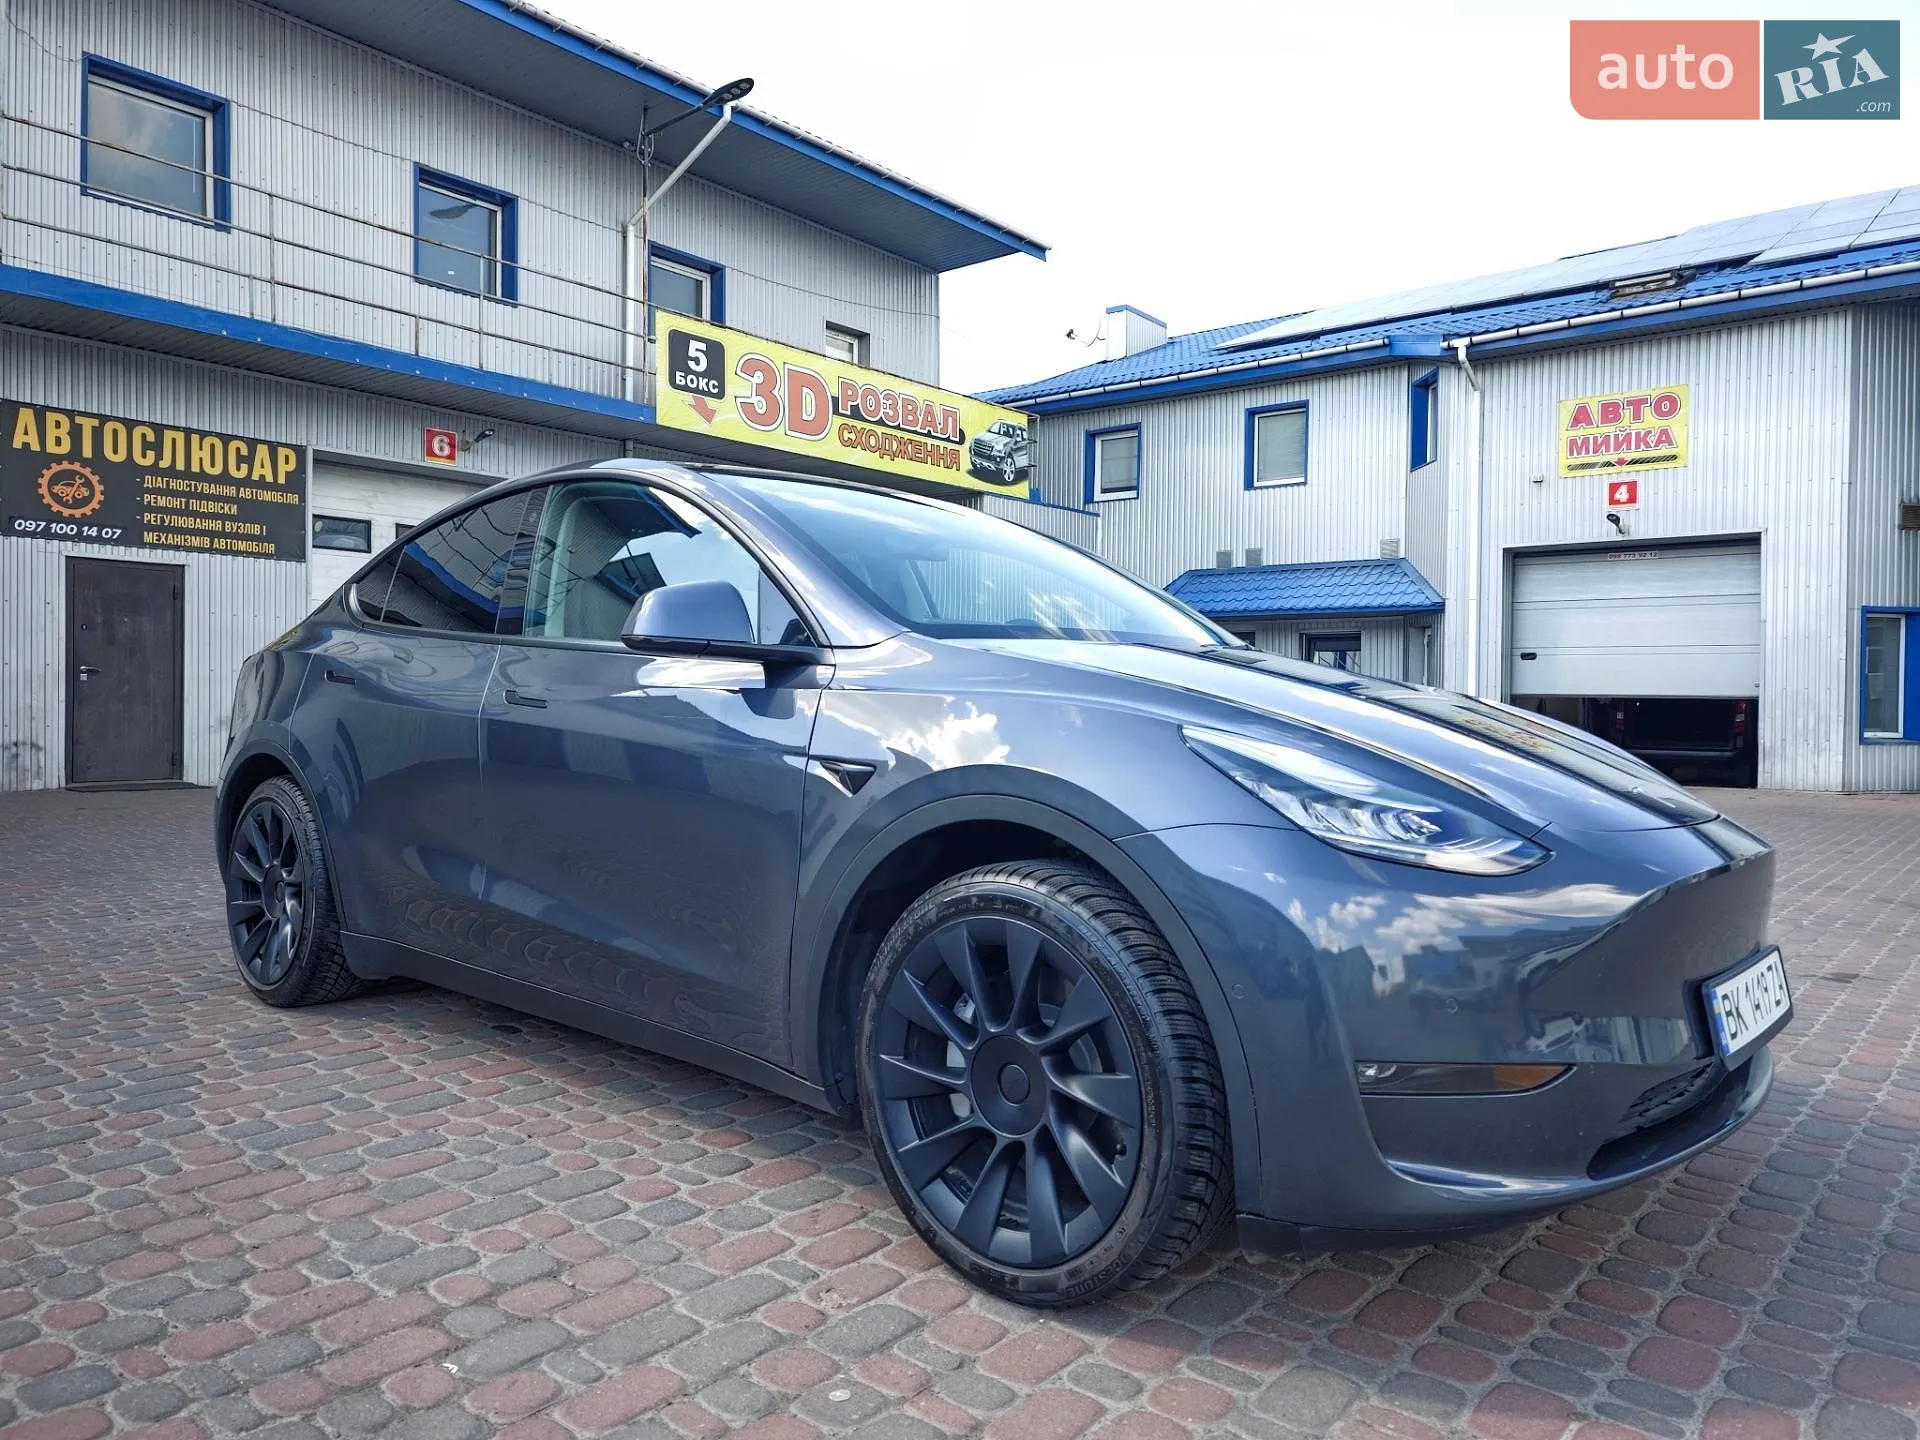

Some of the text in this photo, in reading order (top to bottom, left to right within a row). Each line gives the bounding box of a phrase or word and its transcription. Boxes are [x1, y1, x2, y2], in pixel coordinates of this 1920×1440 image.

[687, 339, 708, 372] 5
[675, 370, 719, 395] БОКС
[735, 353, 960, 441] 3D РОЗВАЛ
[1566, 392, 1681, 431] АВТО
[12, 407, 297, 484] АВТОСЛЮСАР
[432, 435, 450, 457] 6
[838, 423, 960, 471] СХОДЖЕННЯ
[1567, 426, 1677, 459] МИЙКА
[143, 475, 237, 497] ДІАГНОСТУВАННЯ
[238, 487, 299, 505] АВТОМОБІЛЯ
[143, 494, 187, 510] РЕМОНТ
[189, 499, 238, 515] ПІДВІСКИ
[1614, 484, 1629, 502] 4
[14, 519, 122, 539] 097 100 14 07
[143, 512, 222, 531] РЕГУЛЮВАННЯ
[224, 521, 260, 535] ВУЗЛІВ
[143, 531, 275, 554] МЕХАНІЗМІВ АВТОМОБІЛЯ
[1721, 986, 1748, 1041] BK
